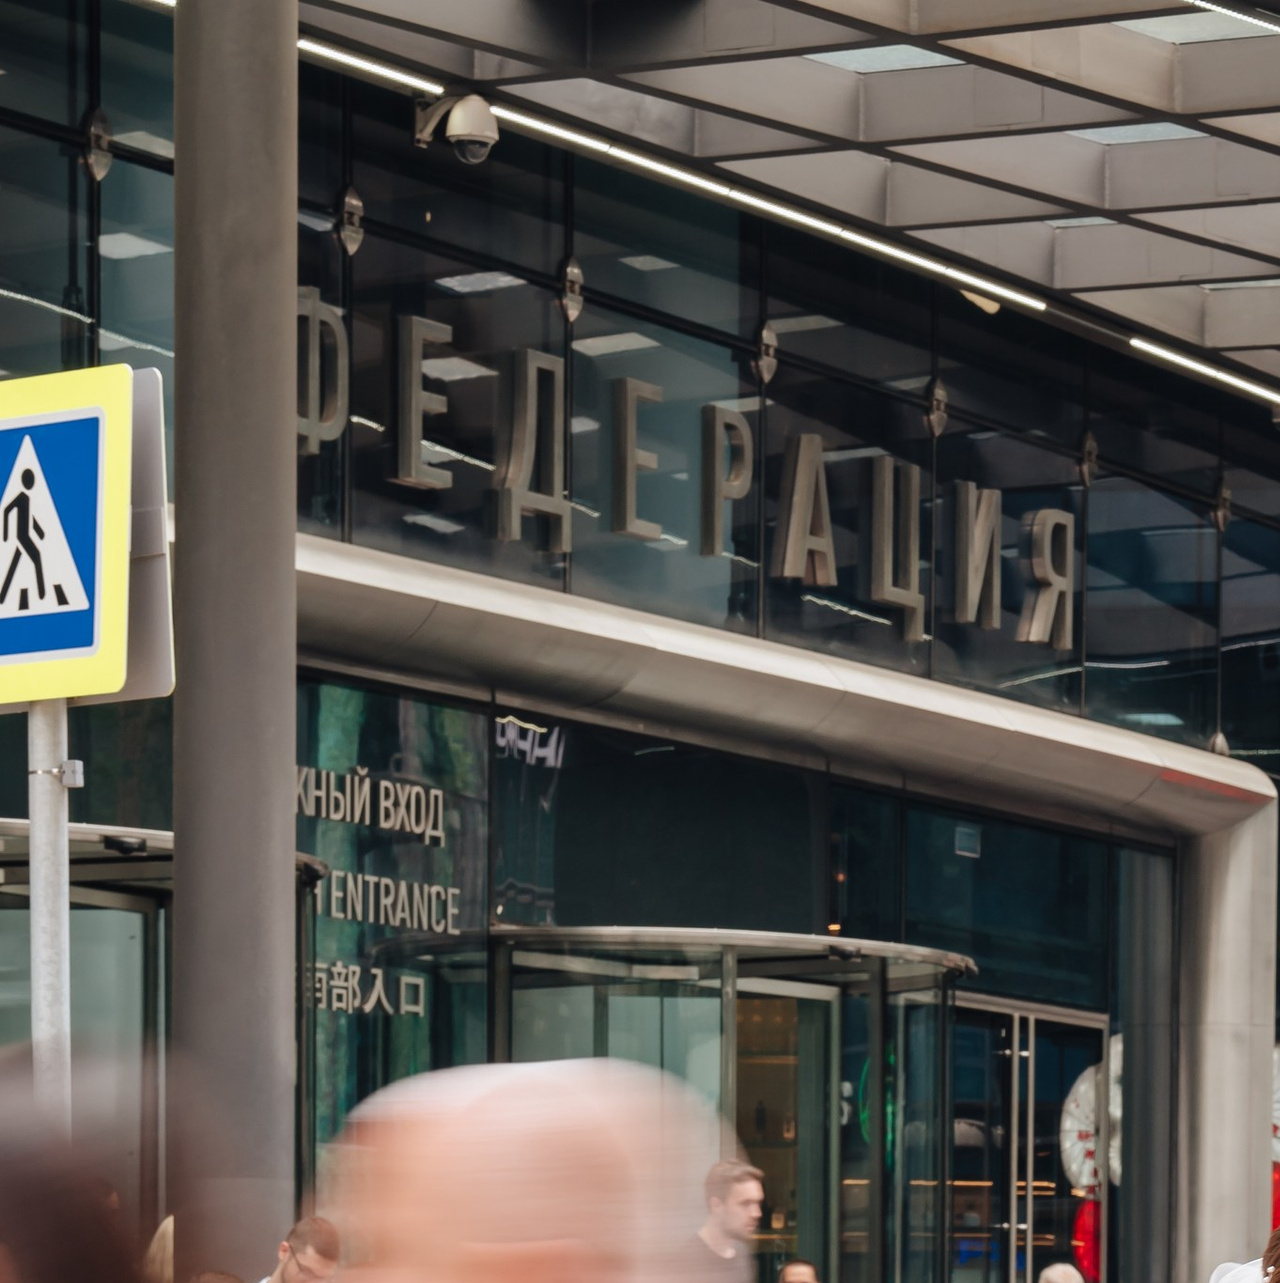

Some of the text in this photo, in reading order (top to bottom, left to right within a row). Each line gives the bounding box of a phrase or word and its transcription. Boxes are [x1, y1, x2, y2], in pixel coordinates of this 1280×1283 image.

[297, 285, 1074, 650] ФЕДЕРАЦИЯ
[379, 780, 445, 848] ВХОД
[331, 870, 461, 936] ENTRANCE
